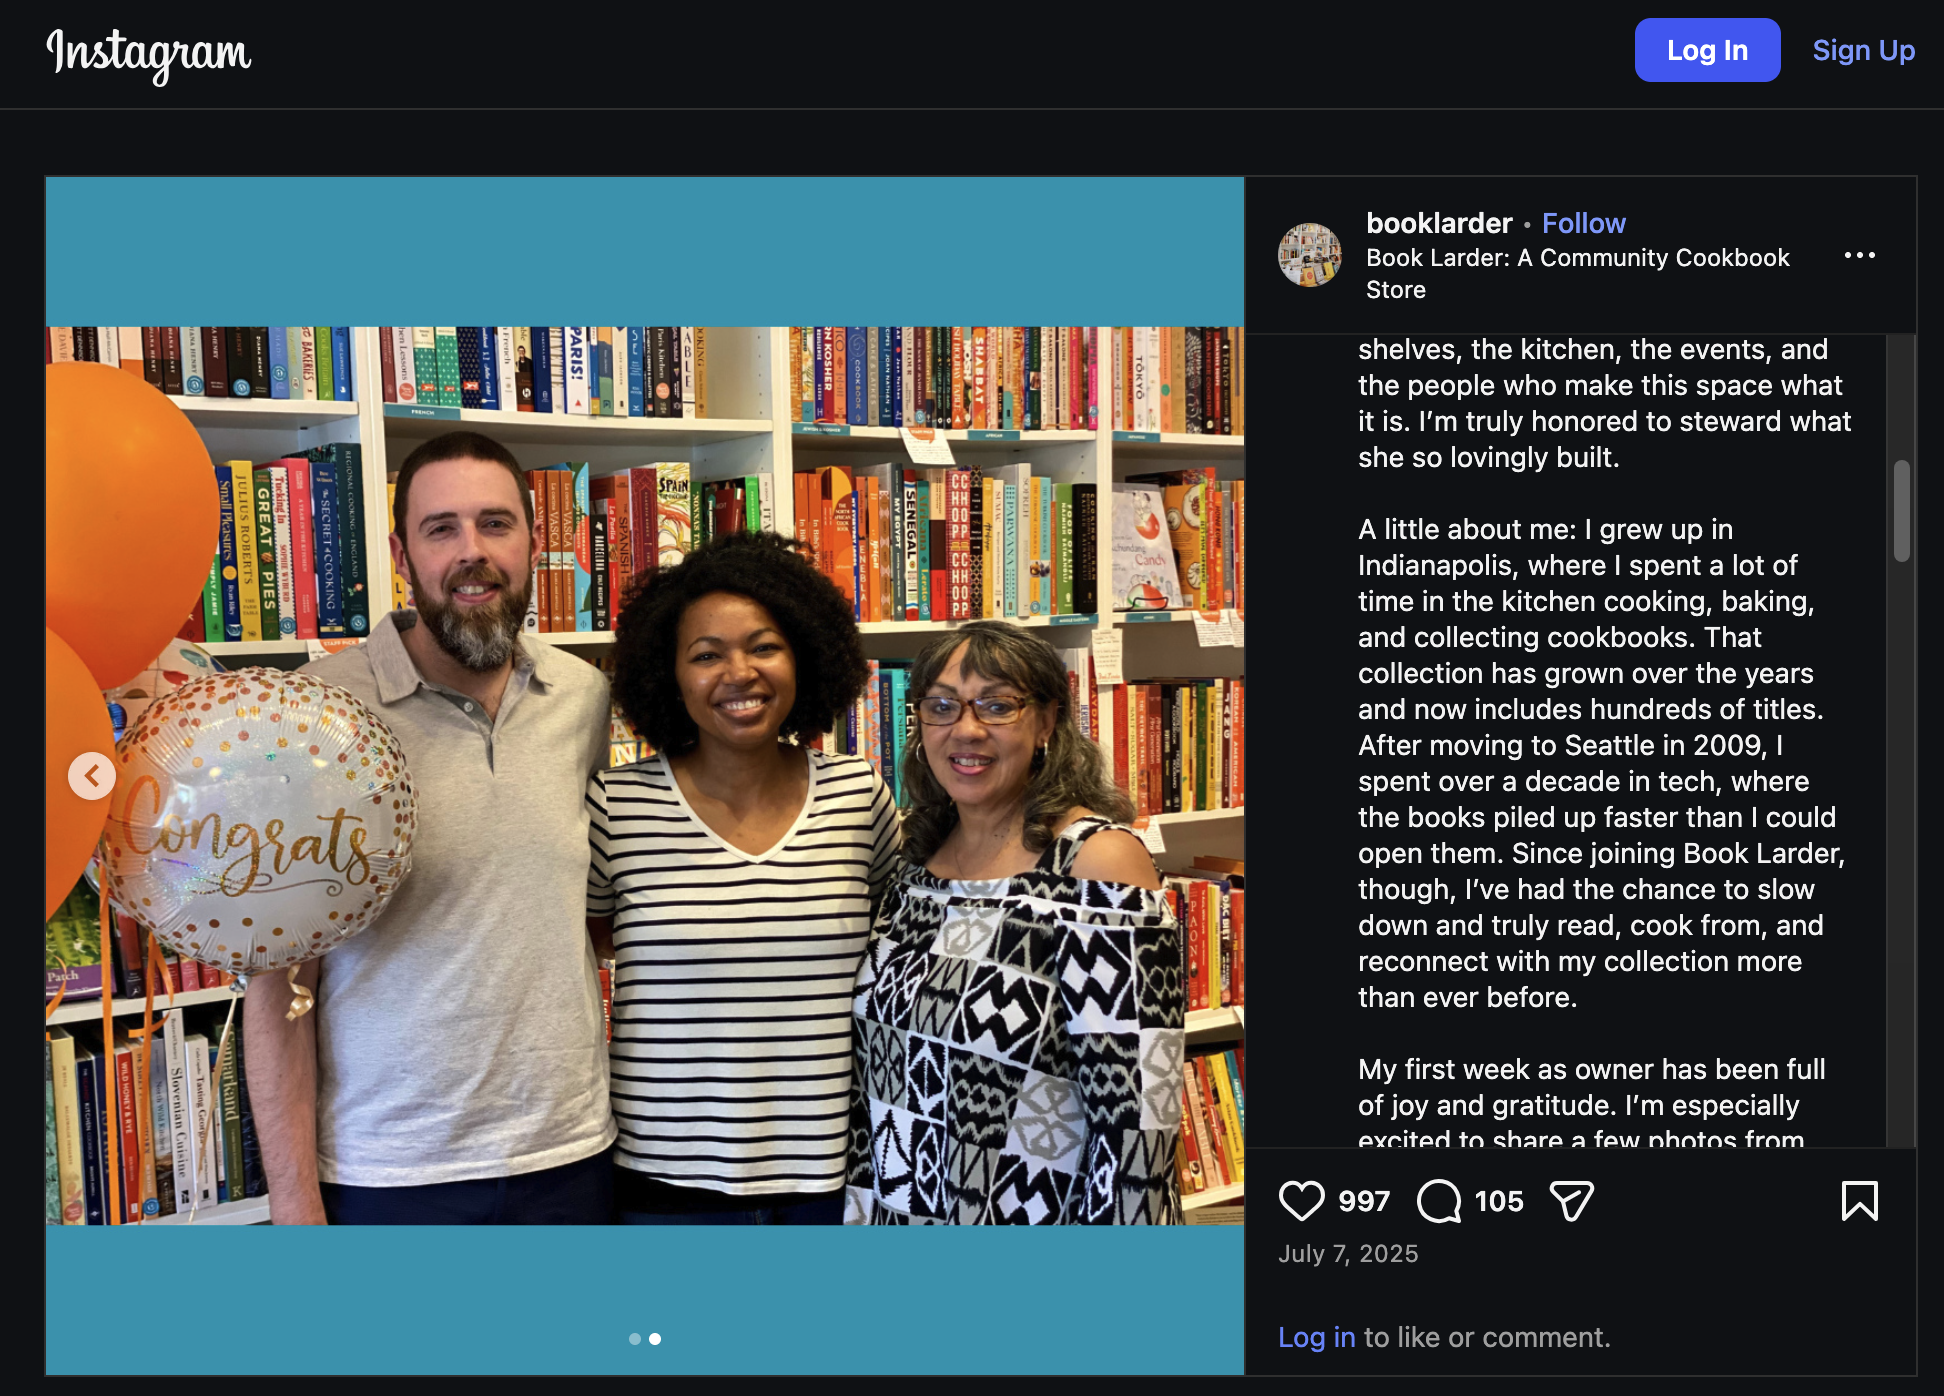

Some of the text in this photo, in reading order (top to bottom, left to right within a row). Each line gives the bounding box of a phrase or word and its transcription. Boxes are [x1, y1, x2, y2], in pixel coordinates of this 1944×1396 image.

[400, 346, 408, 380] Lessons
[502, 332, 511, 364] French
[824, 343, 832, 391] KOSHER
[963, 339, 971, 380] NOSH
[975, 336, 984, 404] SHABBAT
[345, 450, 353, 490] REGIONAL
[551, 482, 557, 490] La
[564, 482, 570, 490] La
[220, 480, 233, 561] Small Pleasures
[274, 476, 286, 524] Tucking In
[347, 492, 356, 530] COOKING
[609, 505, 615, 514] La
[894, 498, 900, 513] MY
[235, 475, 253, 584] JULIUS ROBERTS
[321, 500, 332, 546] SECRET
[550, 511, 559, 548] VASCA
[563, 511, 572, 548] VASCA
[906, 491, 916, 559] SENEGAL
[919, 494, 928, 551] Africana
[1006, 501, 1014, 566] PARWANA
[258, 488, 276, 610] GREAT PIES
[280, 544, 288, 570] SOPHIE
[350, 539, 358, 578] ENGLAND
[619, 516, 629, 574] SPANISH
[951, 474, 960, 616] CHOP CHOP
[960, 474, 969, 616] CHOP CHOP
[1135, 554, 1166, 567] Candy
[323, 553, 336, 609] COOKING
[859, 545, 867, 601] ENEBLA
[122, 775, 382, 897] Congrats
[1189, 900, 1198, 957] PAON
[47, 970, 79, 982] Patch
[120, 1061, 129, 1082] WILD
[196, 1075, 206, 1108] Tasting
[122, 1084, 131, 1110] HONEY
[171, 1067, 184, 1129] Slovenian
[125, 1119, 133, 1134] RYE
[174, 1131, 186, 1178] Cuisine
